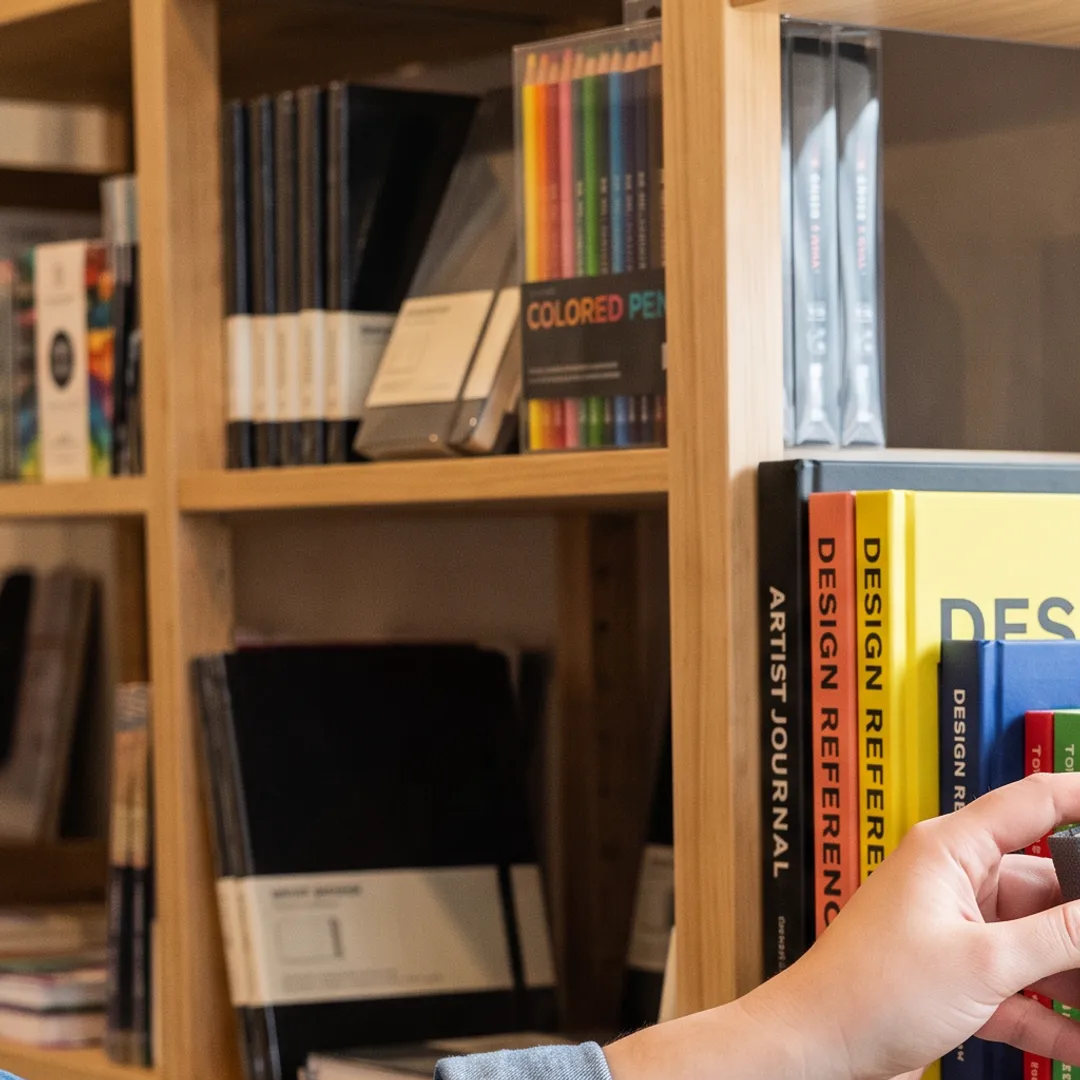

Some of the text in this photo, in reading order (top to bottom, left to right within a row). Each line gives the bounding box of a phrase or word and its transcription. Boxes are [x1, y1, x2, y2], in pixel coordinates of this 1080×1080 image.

[527, 293, 624, 330] COLORED
[818, 537, 839, 690] DESIGN
[768, 586, 790, 878] ARTIST JOURNAL
[864, 537, 885, 877] DESIGN REFERE
[953, 689, 966, 777] DESIGN
